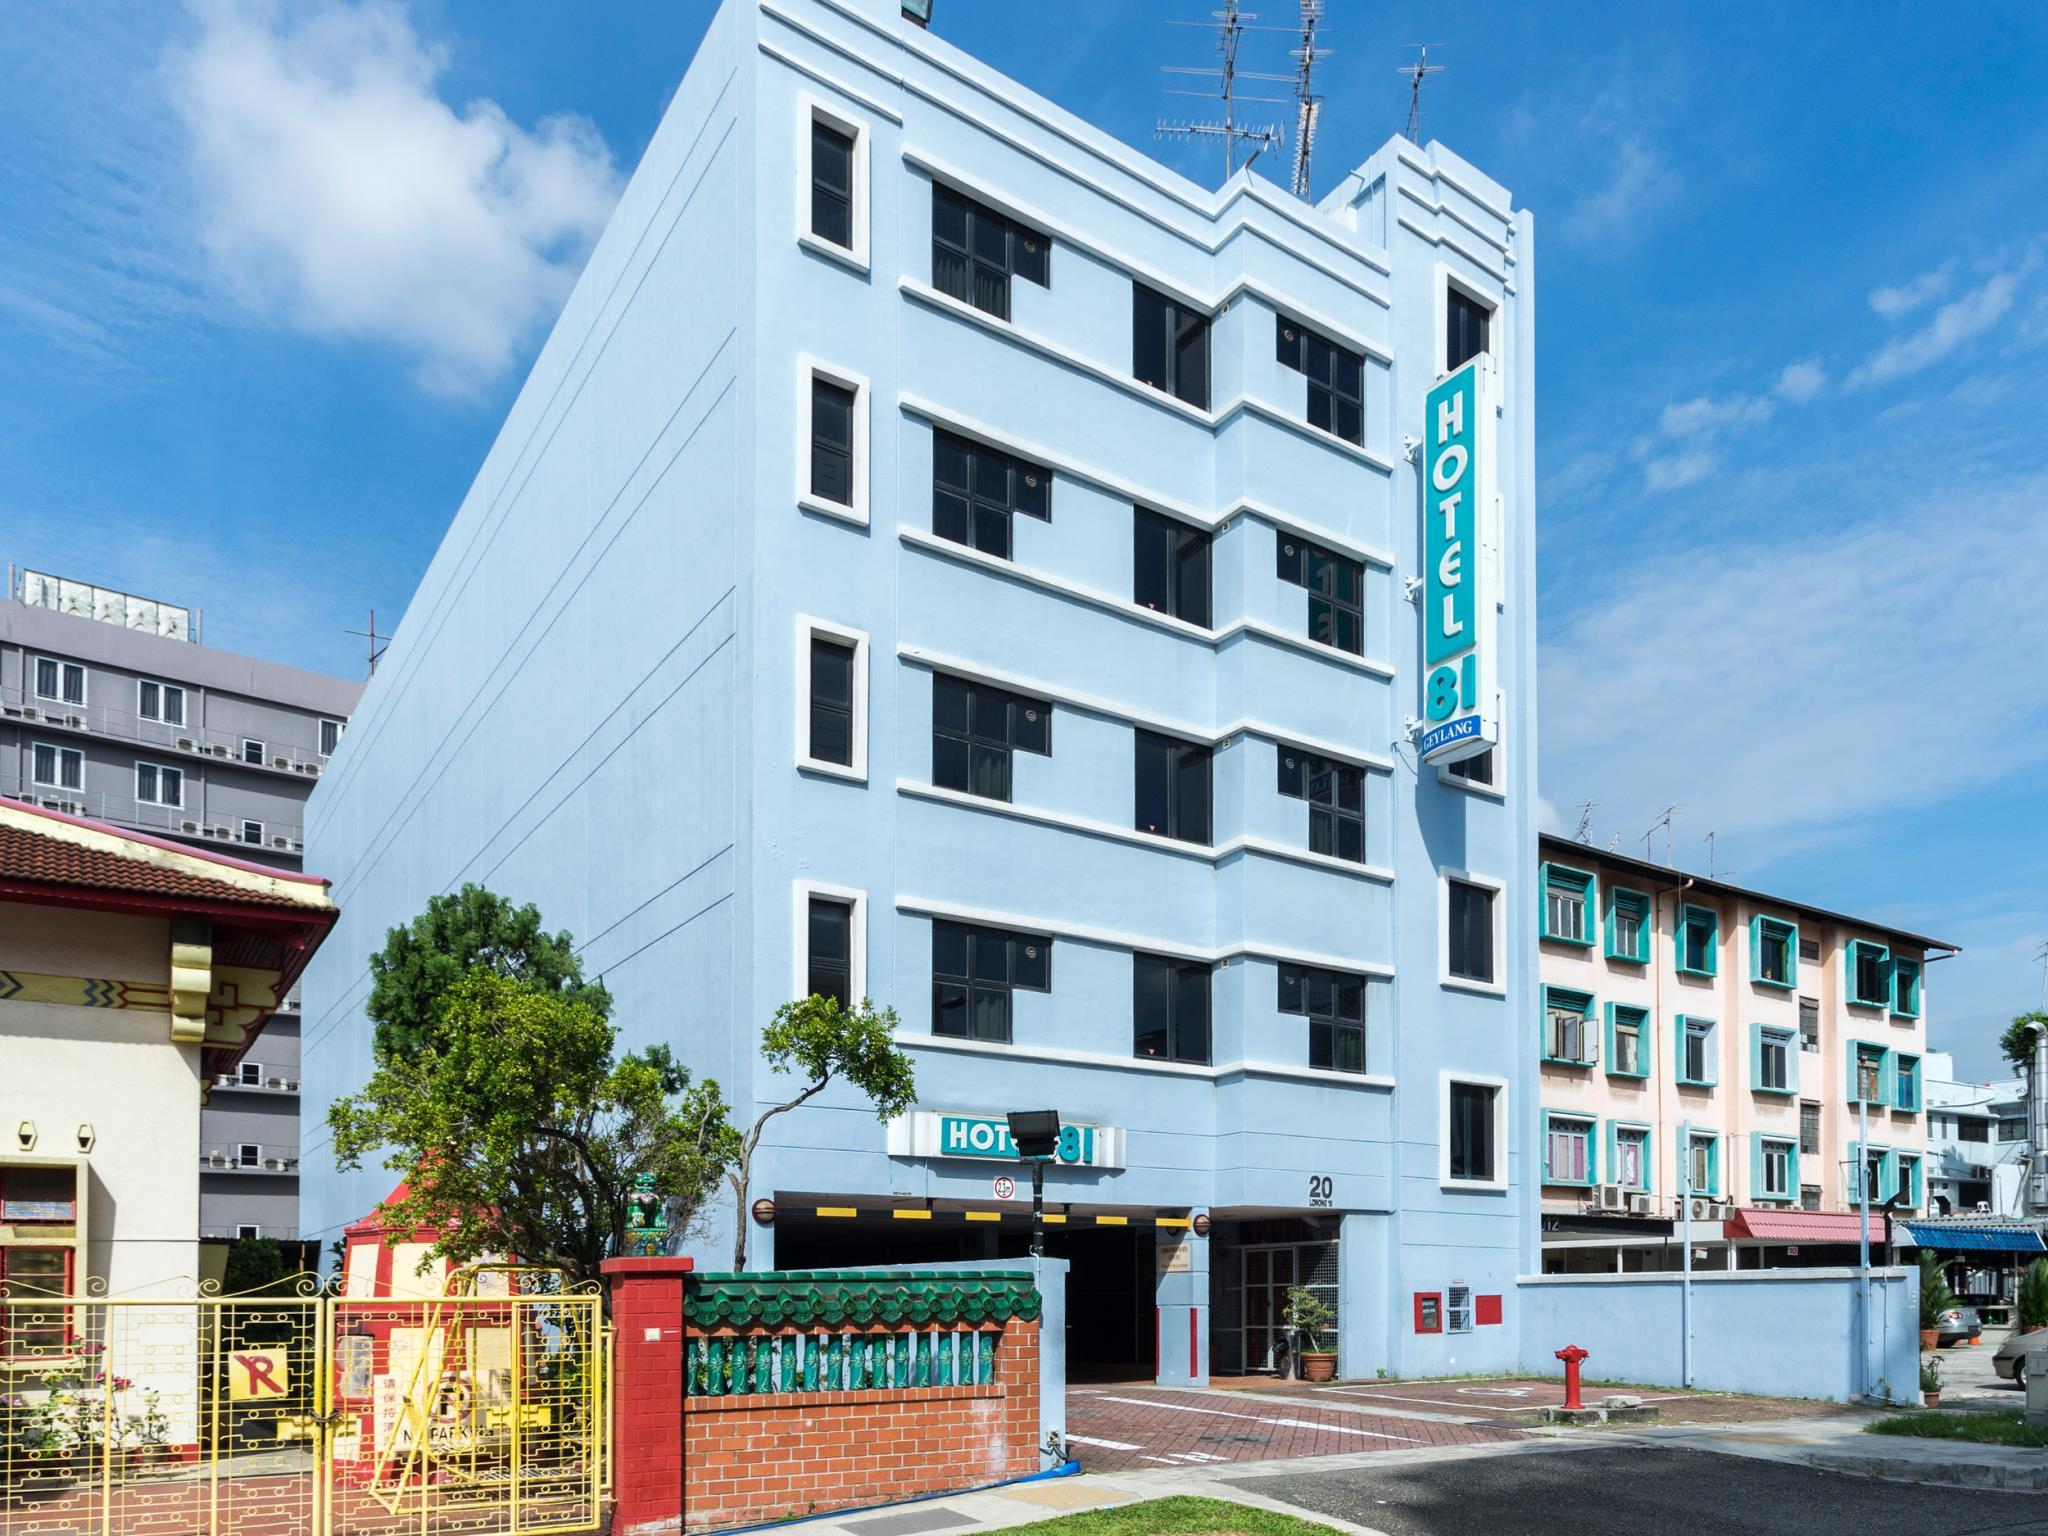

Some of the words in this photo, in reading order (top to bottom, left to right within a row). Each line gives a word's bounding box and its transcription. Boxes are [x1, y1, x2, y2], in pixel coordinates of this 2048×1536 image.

[1432, 390, 1468, 637] HOTEL
[1426, 653, 1476, 721] 81
[1423, 720, 1472, 751] GEYLANG
[950, 1121, 1019, 1152] HOT
[1058, 1125, 1093, 1163] 81
[1309, 1175, 1333, 1199] 20
